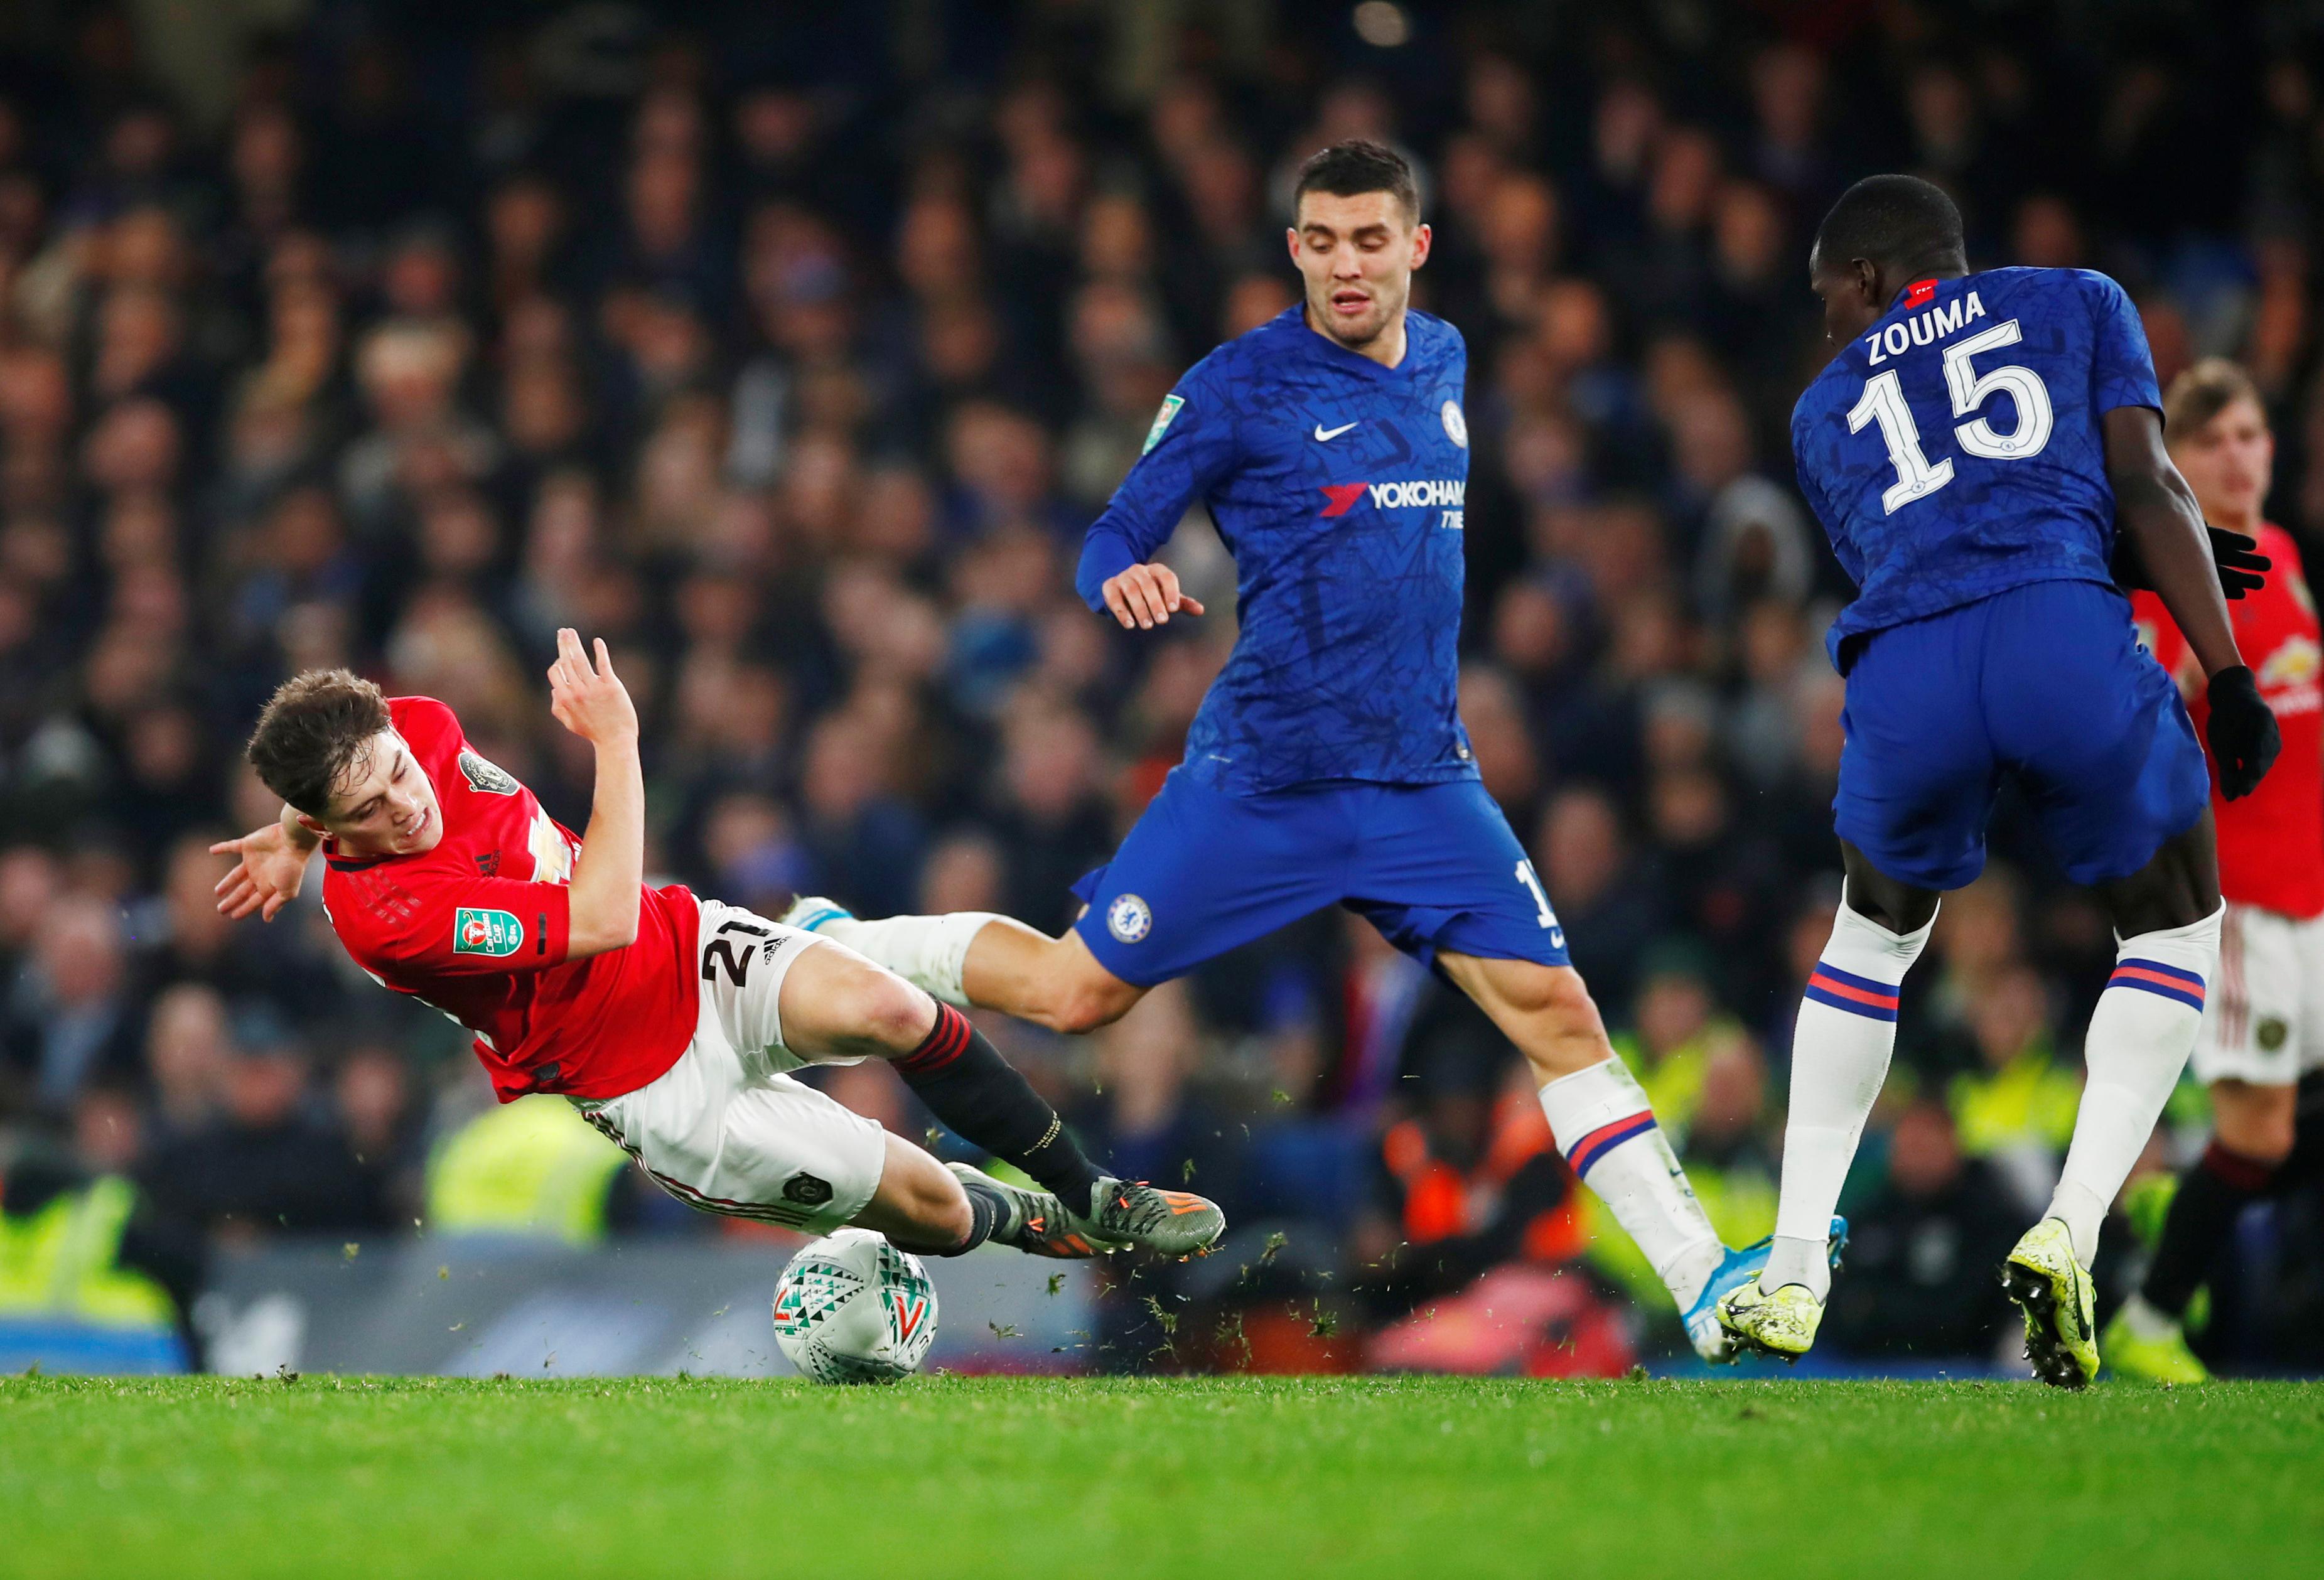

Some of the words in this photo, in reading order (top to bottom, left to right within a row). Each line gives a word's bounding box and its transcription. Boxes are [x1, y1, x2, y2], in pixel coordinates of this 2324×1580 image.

[1865, 291, 1986, 367] ZOUMA
[1846, 318, 2053, 516] 15
[1369, 480, 1465, 509] YOKOHAM
[487, 849, 500, 878] didas
[1515, 857, 1558, 928] 1
[482, 913, 495, 953] Carabao
[493, 924, 502, 944] Cup
[702, 920, 773, 987] 21
[765, 936, 792, 965] adidas
[1043, 1120, 1061, 1148] UNITED
